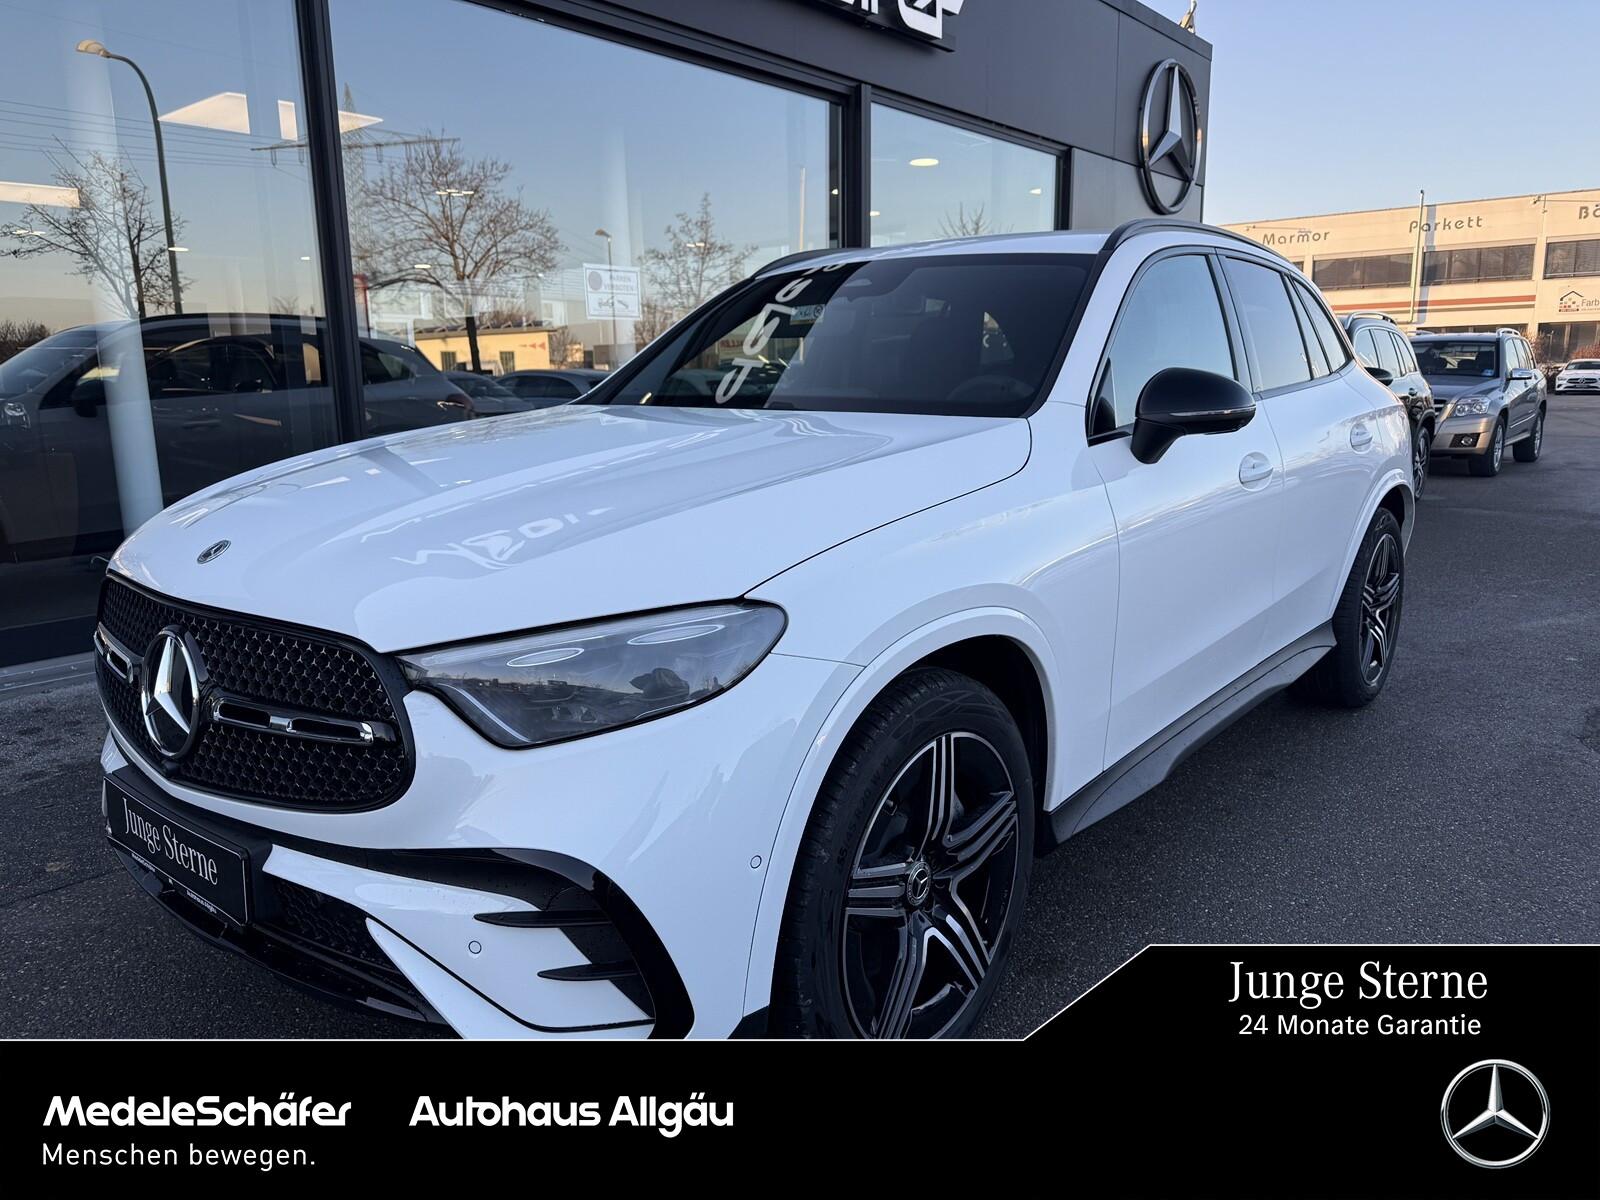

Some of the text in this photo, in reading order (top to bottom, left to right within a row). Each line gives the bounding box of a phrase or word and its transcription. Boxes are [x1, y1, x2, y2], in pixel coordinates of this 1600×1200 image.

[1408, 215, 1483, 233] Parkett
[1262, 231, 1330, 246] Marmor
[122, 797, 218, 885] Junge Sterne
